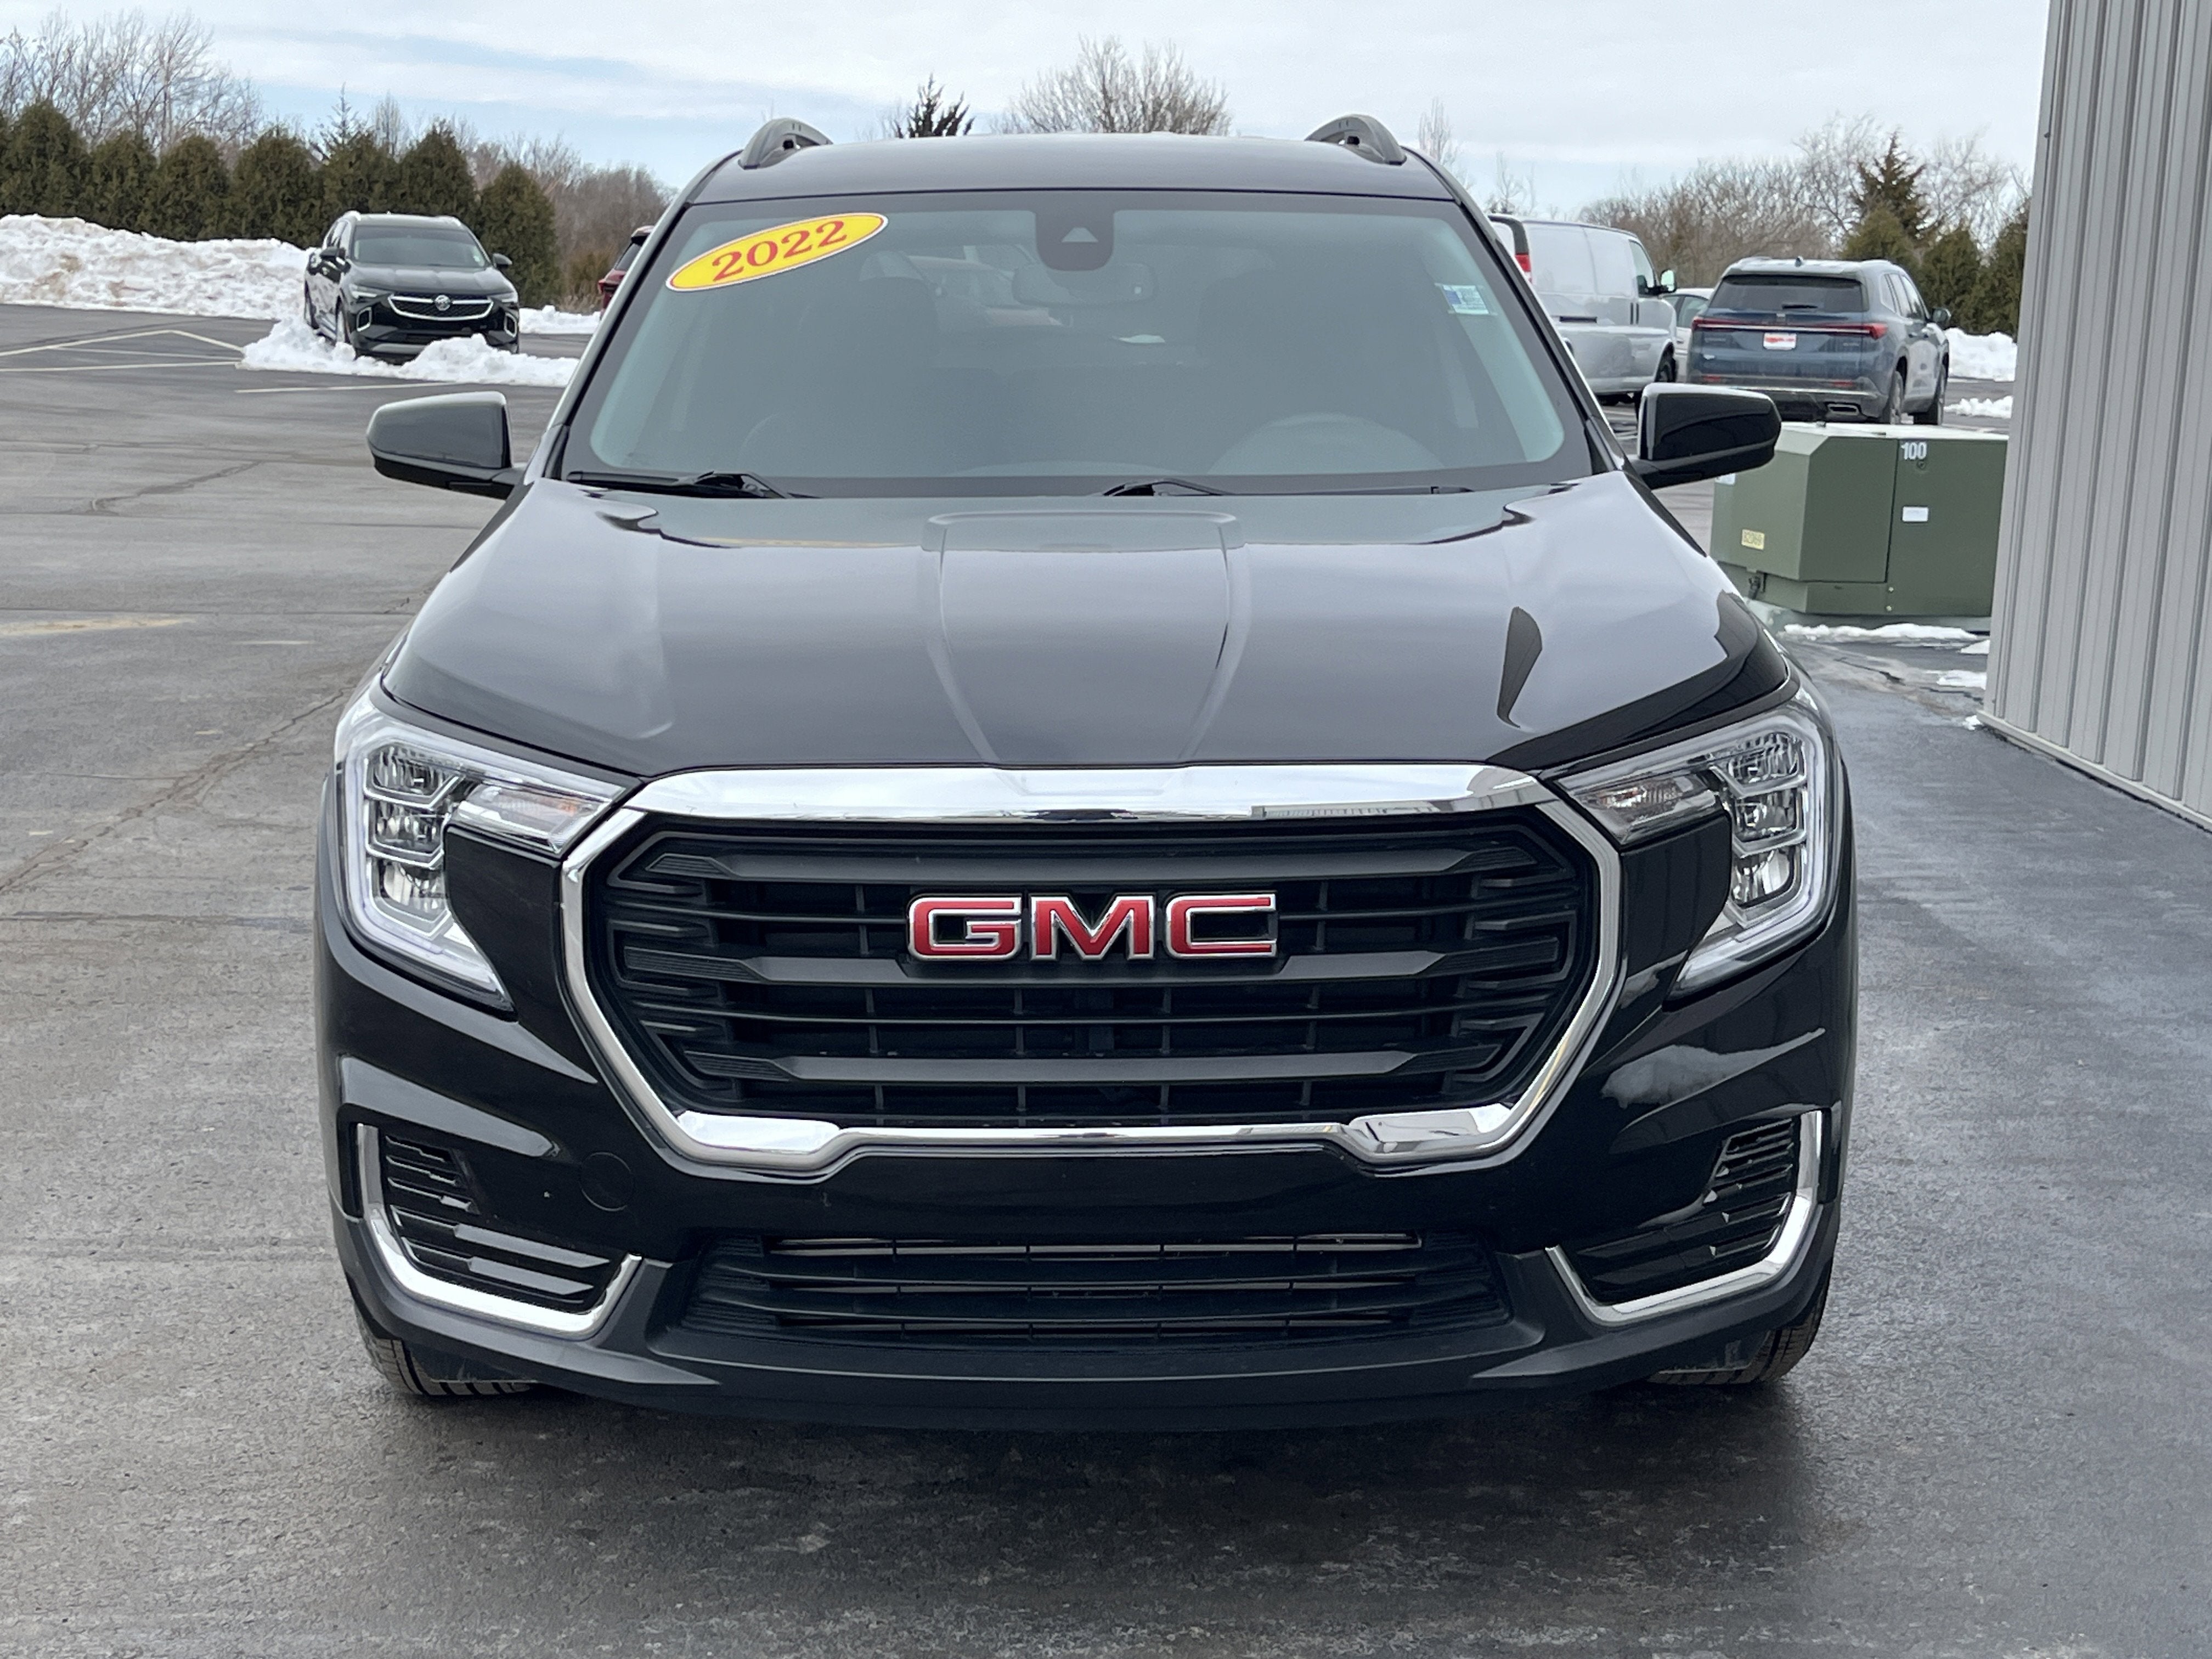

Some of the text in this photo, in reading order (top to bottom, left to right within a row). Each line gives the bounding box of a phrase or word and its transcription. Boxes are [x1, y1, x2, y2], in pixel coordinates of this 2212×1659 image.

[712, 221, 848, 281] 2022
[1901, 442, 1927, 460] 100
[908, 892, 1277, 961] GMC
